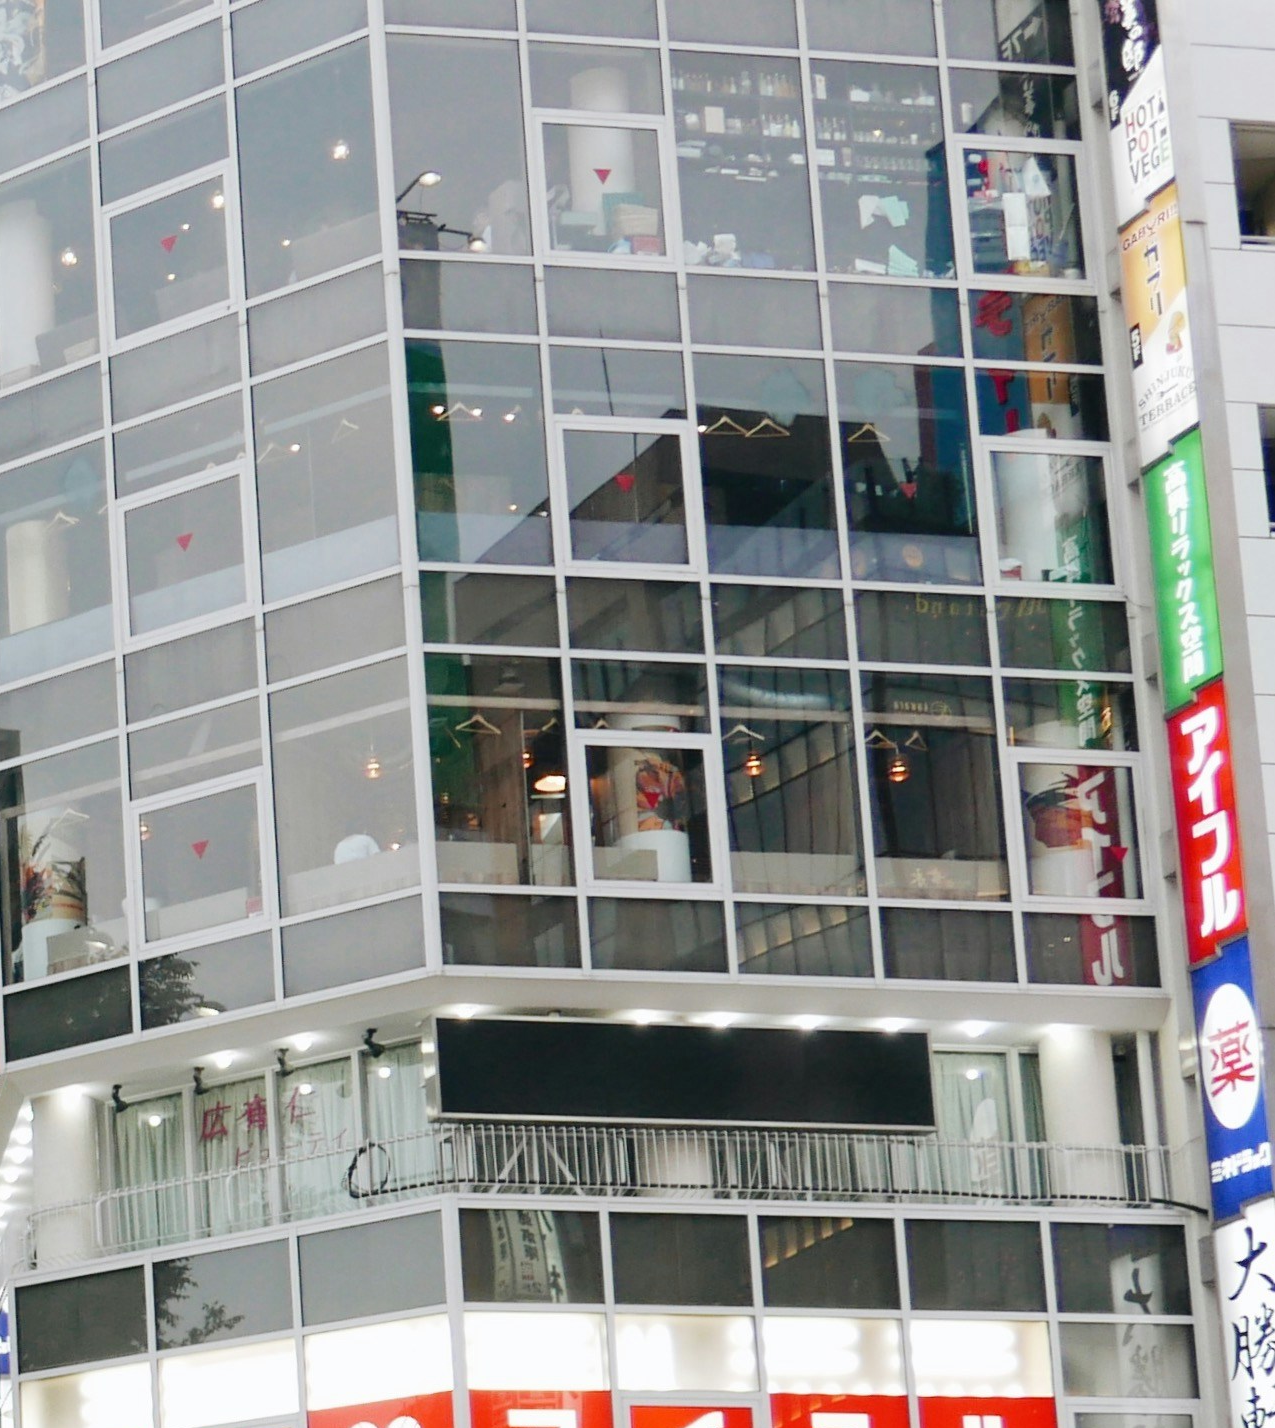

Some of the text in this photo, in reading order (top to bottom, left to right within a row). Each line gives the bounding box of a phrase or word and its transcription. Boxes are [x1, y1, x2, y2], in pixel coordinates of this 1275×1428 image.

[1124, 94, 1158, 132] HOT
[1128, 121, 1158, 154] POT
[1129, 138, 1169, 183] VEGE
[1130, 325, 1142, 361] 5F
[1138, 364, 1196, 411] SHINJUKU
[1139, 383, 1197, 425] TERRACE
[1180, 705, 1243, 938] アイフル
[1208, 1020, 1256, 1097] 薬
